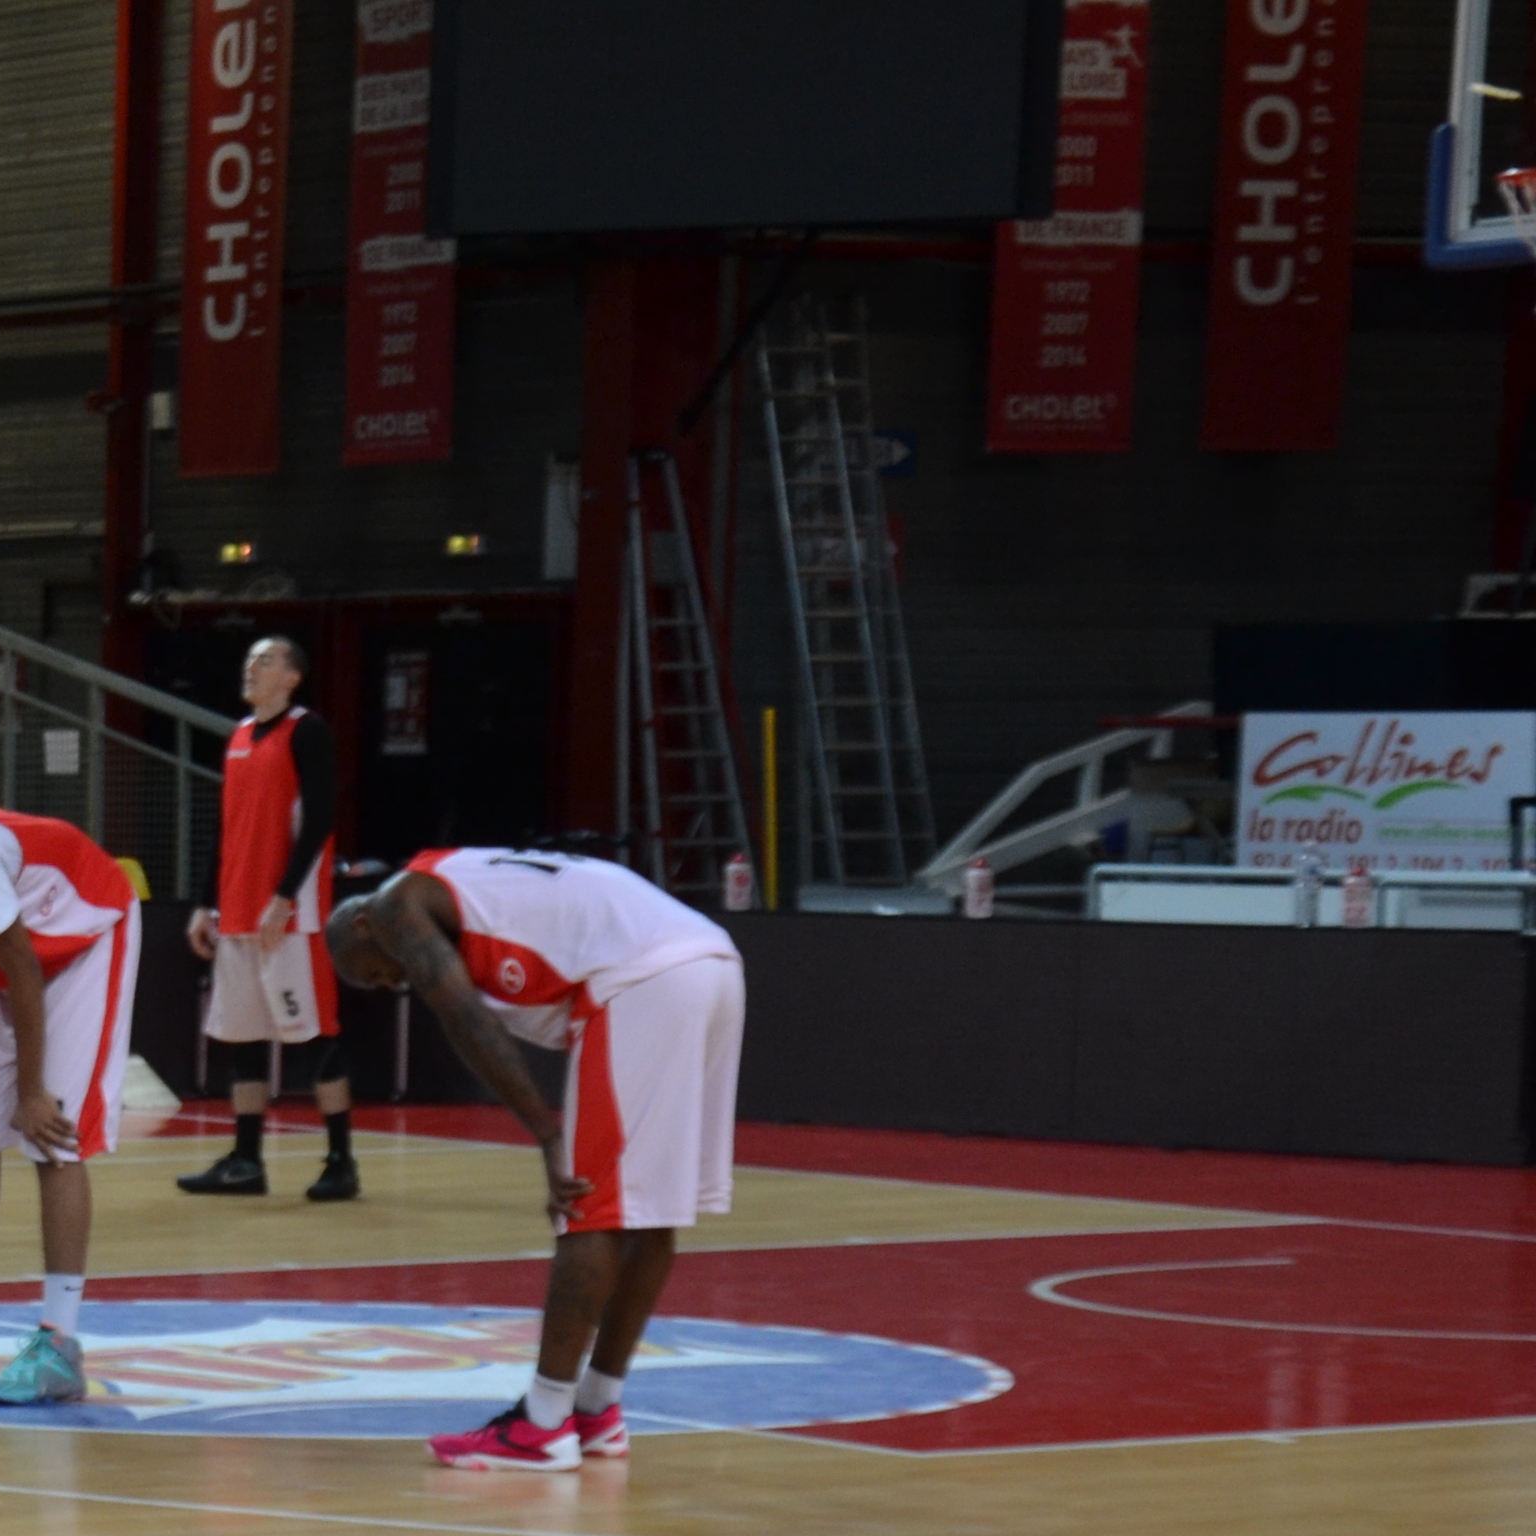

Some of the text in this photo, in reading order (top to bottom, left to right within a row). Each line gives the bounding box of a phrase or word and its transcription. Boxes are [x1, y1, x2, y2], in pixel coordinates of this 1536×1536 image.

[1253, 719, 1506, 787] Collines
[1283, 808, 1364, 845] radio
[282, 990, 300, 1017] 5
